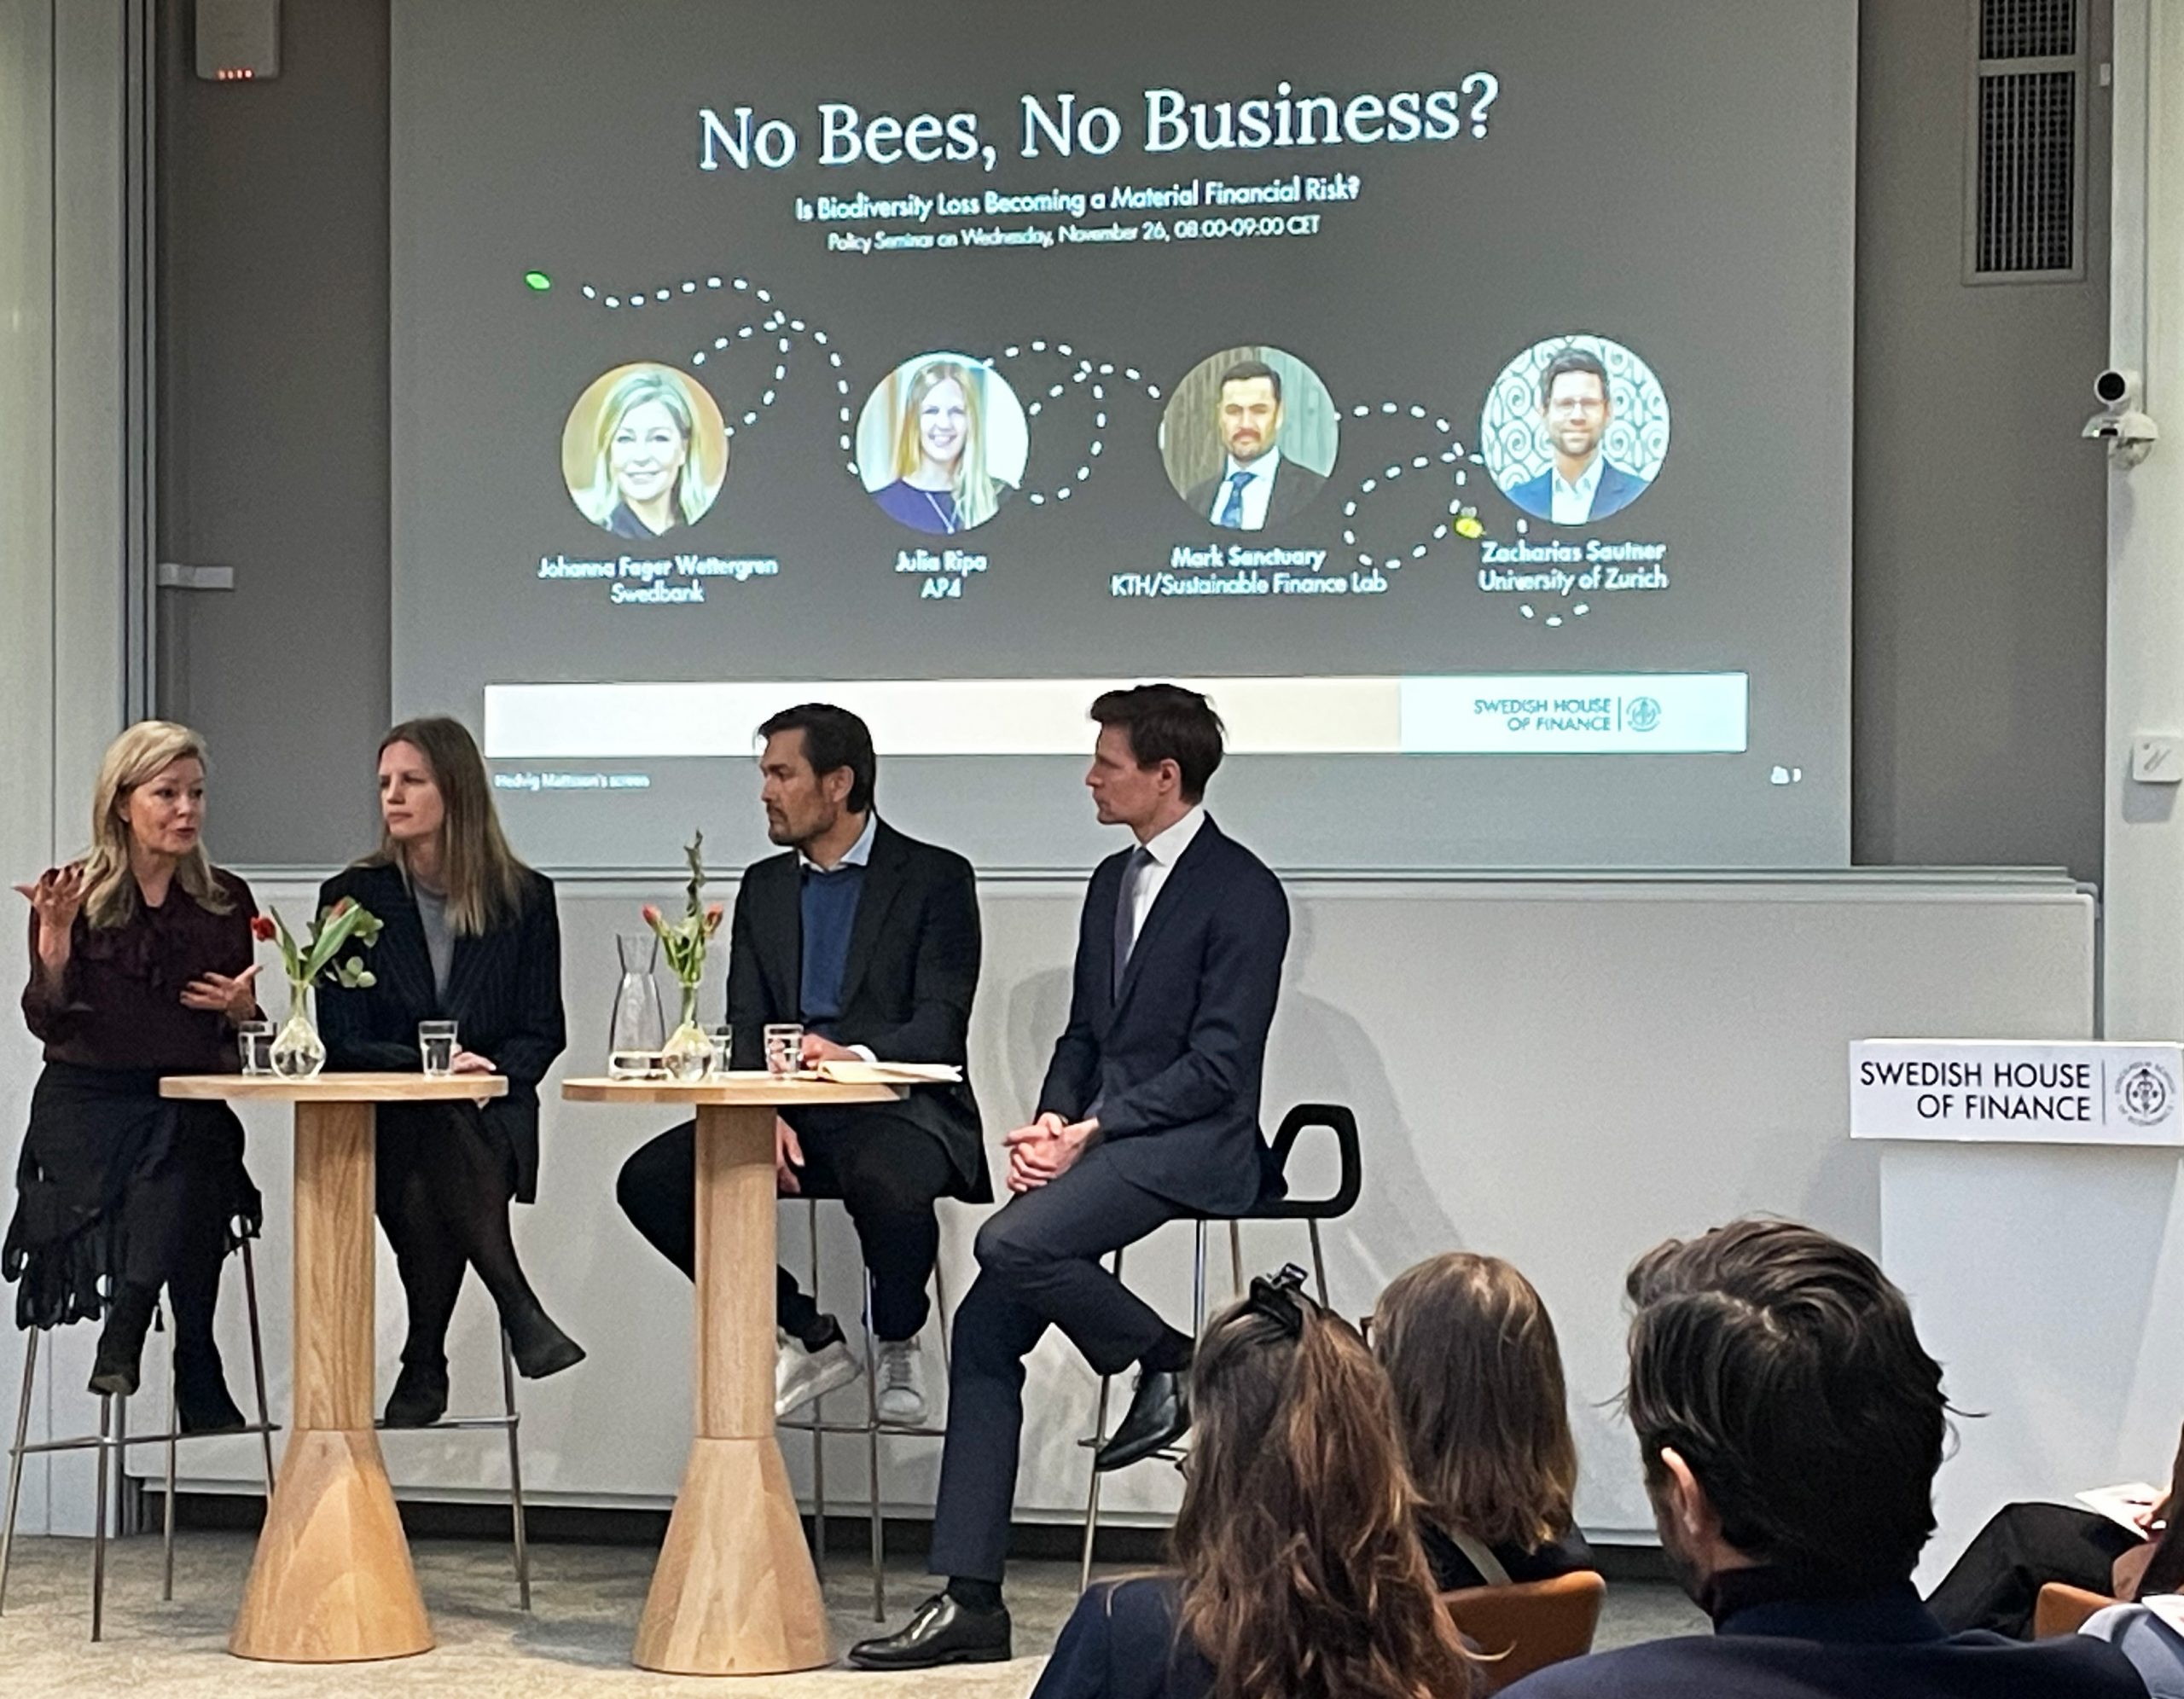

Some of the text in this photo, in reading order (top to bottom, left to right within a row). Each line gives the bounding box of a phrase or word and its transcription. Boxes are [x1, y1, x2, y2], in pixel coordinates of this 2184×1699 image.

[699, 72, 1498, 171] No Bees, No Business?
[796, 172, 1361, 223] Is Biodiversity Loss Becoming a Material Financial Risk?
[937, 234, 958, 247] on
[1058, 222, 1138, 243] November
[1141, 221, 1170, 242] 26,
[1286, 214, 1321, 235] CET
[895, 548, 987, 579] Julia Ripa
[1170, 543, 1327, 573] Mark Sanctuary
[1481, 538, 1667, 563] Zacharias Sautner
[537, 555, 616, 578] Johanna
[619, 556, 673, 584] Fager
[1112, 568, 1388, 597] KTH/Sustainable Finance Lab
[1478, 563, 1670, 596] University of Zurich
[610, 577, 705, 604] Swedbank
[921, 577, 961, 599] AP4
[1473, 698, 1612, 715] SWEDISH HOUSE
[1507, 716, 1612, 732] OF FINANCE
[1860, 1061, 2091, 1089] SWEDISH HOUSE
[1916, 1093, 2092, 1122] OF FINANCE
